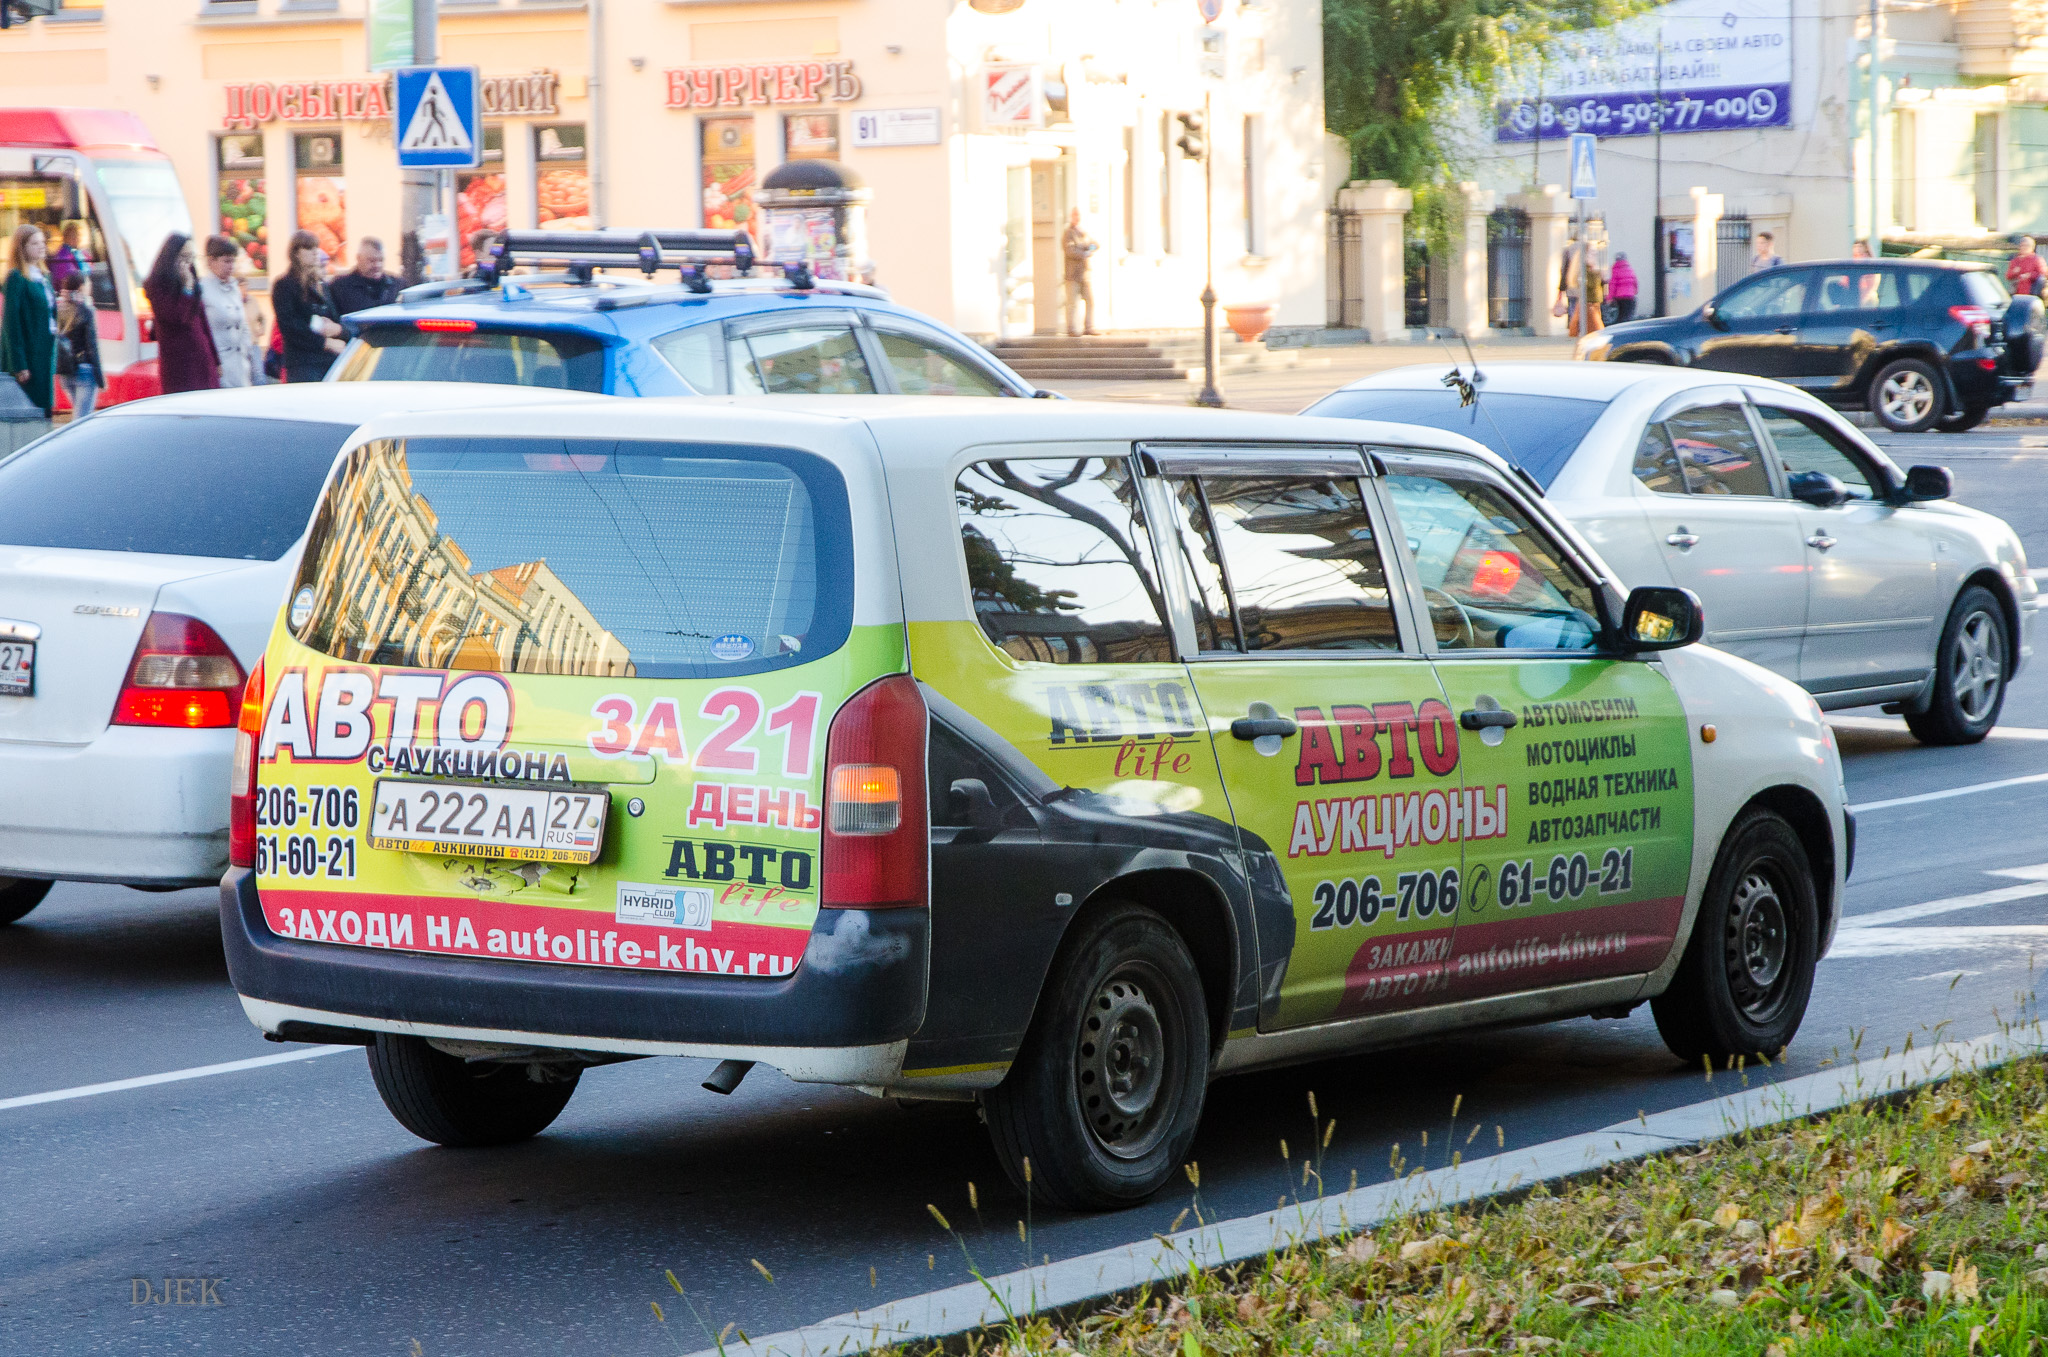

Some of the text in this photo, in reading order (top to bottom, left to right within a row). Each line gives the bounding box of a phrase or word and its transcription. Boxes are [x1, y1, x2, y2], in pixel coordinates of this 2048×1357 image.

[1685, 35, 1738, 52] СВОЕМ
[1742, 33, 1784, 49] АВТО
[859, 115, 878, 140] 91
[1540, 96, 1747, 131] 8-962-503-77-00
[72, 604, 139, 618] COROLLA
[1, 646, 24, 671] 27
[258, 666, 515, 764] АВТО
[1047, 682, 1196, 744] АВТО
[1522, 696, 1639, 728] АВТОМОБИЛИ
[589, 686, 822, 779] ЗА 21
[1294, 697, 1460, 787] АВТО
[1526, 733, 1637, 767] МОТОЦИКЛЫ
[394, 746, 571, 781] АУКЦИОНА
[1113, 736, 1191, 781] life
[1528, 767, 1679, 807] ВОДНАЯ ТЕХНИКА
[257, 786, 359, 829] 206-706
[551, 796, 591, 830] 27
[687, 781, 821, 832] ДЕНЬ
[1288, 784, 1508, 859] АУКЦИОНЫ
[1527, 806, 1661, 844] АВТОЗАПЧАСТИ
[256, 834, 356, 878] 61-60-21
[376, 838, 410, 851] АВТО
[433, 842, 505, 857] АУКЦИОНЫ
[520, 847, 549, 860] (4212)
[552, 850, 588, 862] 206-706
[546, 831, 574, 844] RUS
[665, 840, 811, 890] АВТО
[623, 895, 674, 910] HYBRID
[719, 881, 801, 917] life
[1311, 847, 1634, 931] 206-706 61-60-21
[654, 909, 675, 918] CLUB
[279, 908, 794, 975] ЗАХОДИ НА autolife-khv.ru
[1367, 936, 1451, 970] ЗАКАЖИ
[1361, 970, 1419, 1000] АВТО
[1457, 930, 1627, 978] autolife-khv.ru
